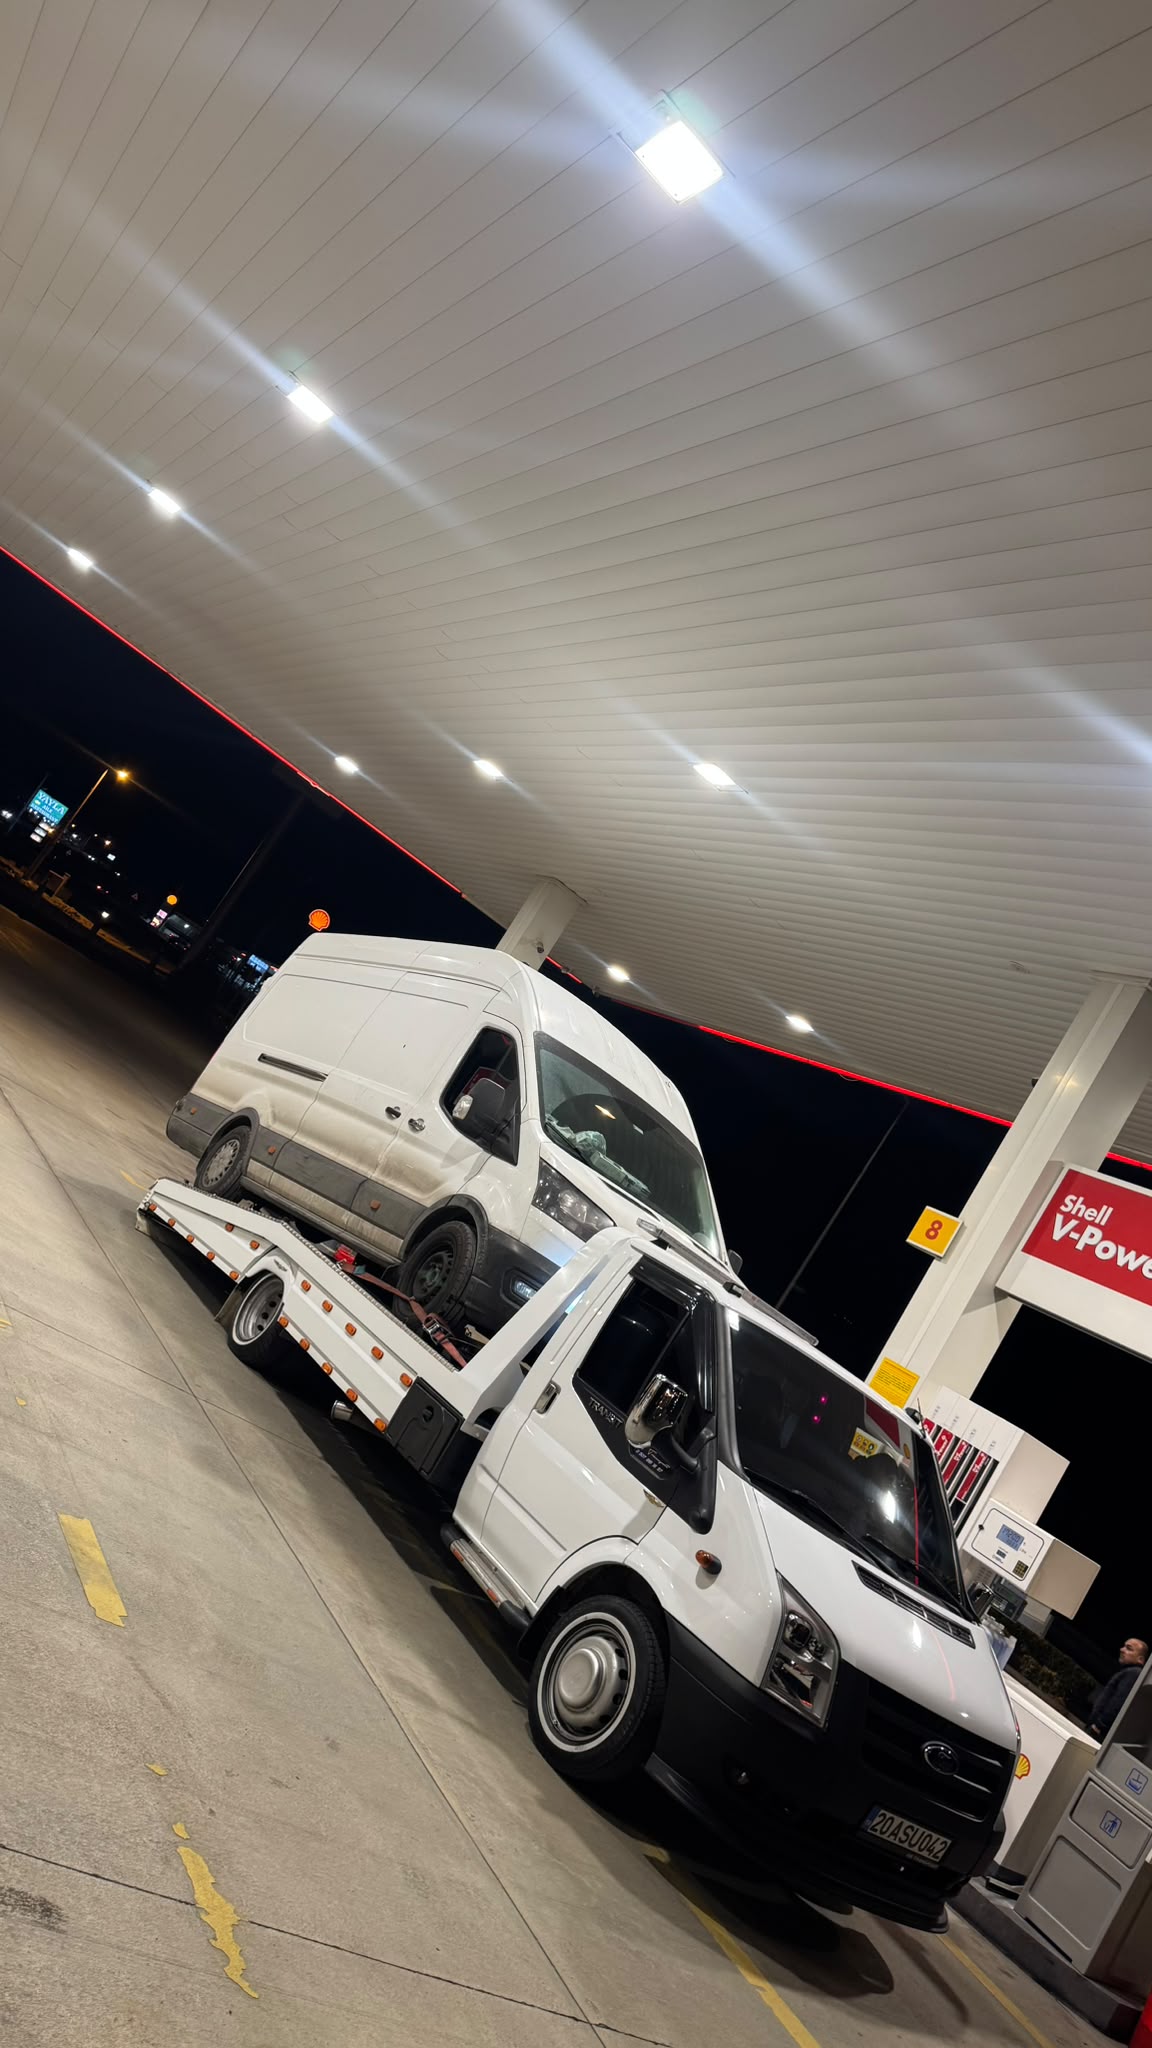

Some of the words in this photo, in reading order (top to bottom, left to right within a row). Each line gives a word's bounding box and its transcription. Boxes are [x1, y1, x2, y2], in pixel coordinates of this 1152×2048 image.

[39, 791, 65, 815] YAYLA
[1060, 1194, 1113, 1226] Shell
[925, 1220, 943, 1240] 8
[589, 1396, 623, 1428] TRANSIT
